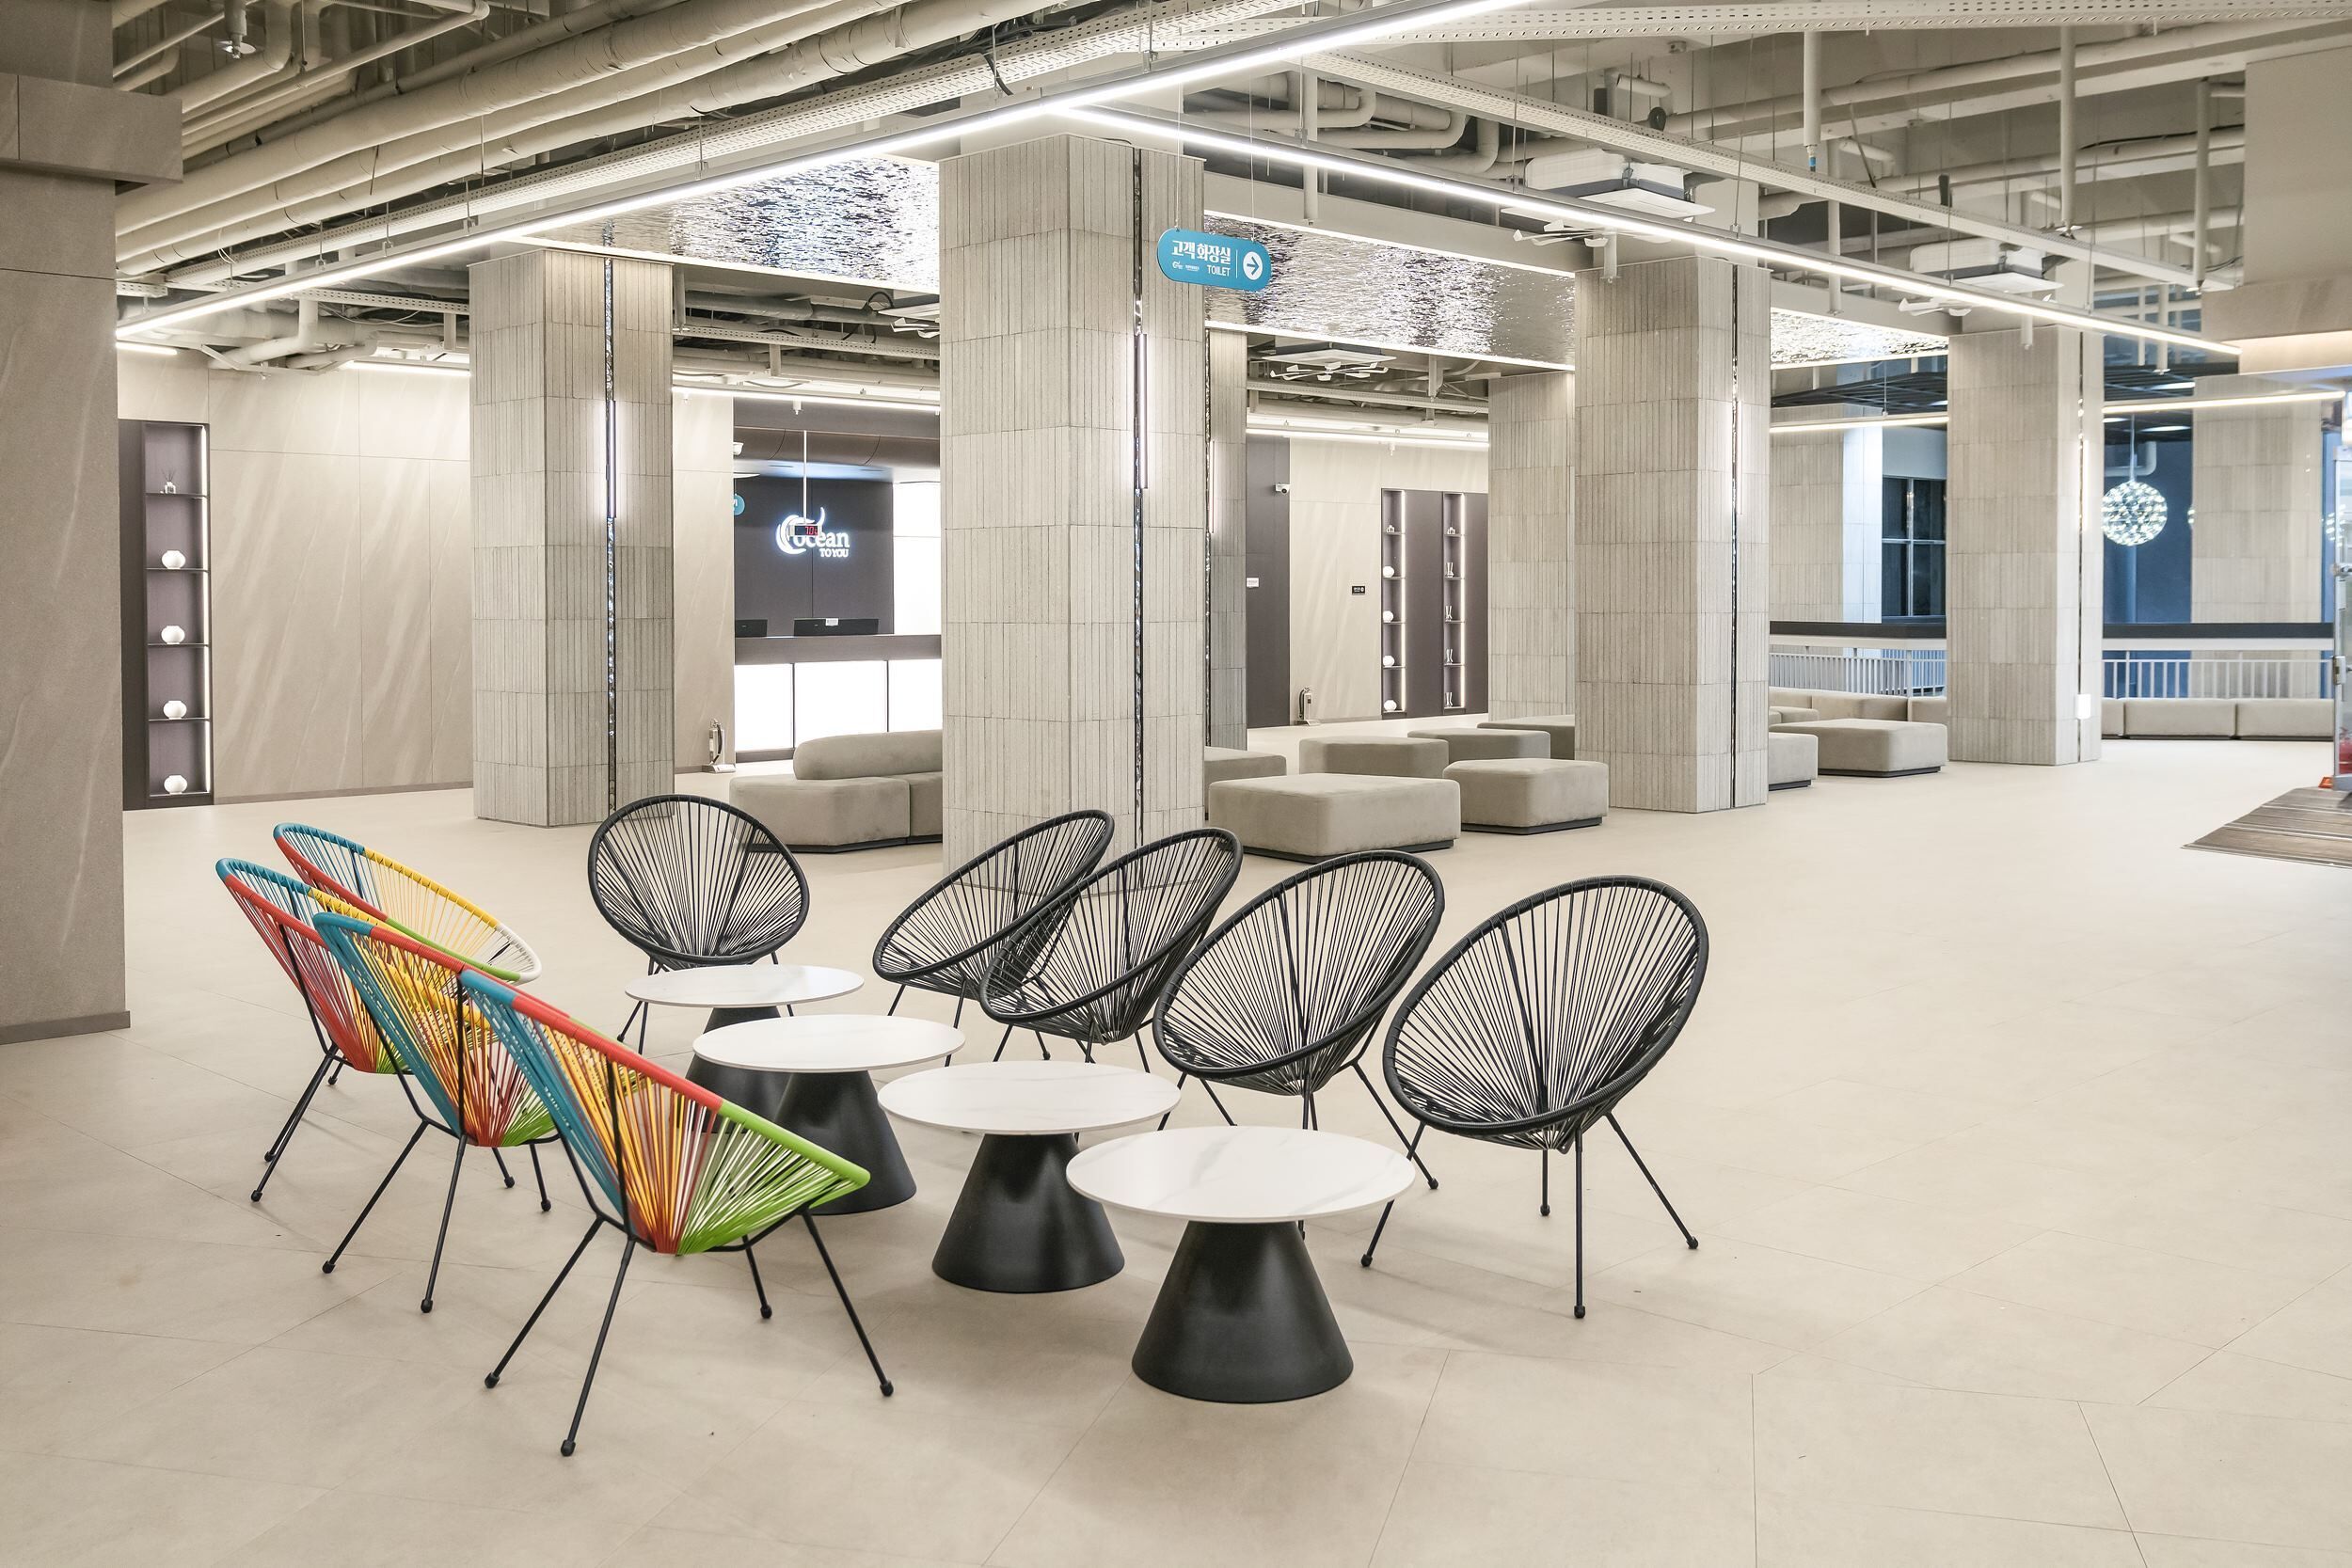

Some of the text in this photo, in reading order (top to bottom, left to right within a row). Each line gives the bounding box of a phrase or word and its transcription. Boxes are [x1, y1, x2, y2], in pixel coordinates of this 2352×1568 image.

[1171, 240, 1196, 260] 고객
[1197, 243, 1232, 265] 화장실
[1207, 264, 1232, 277] TOILET
